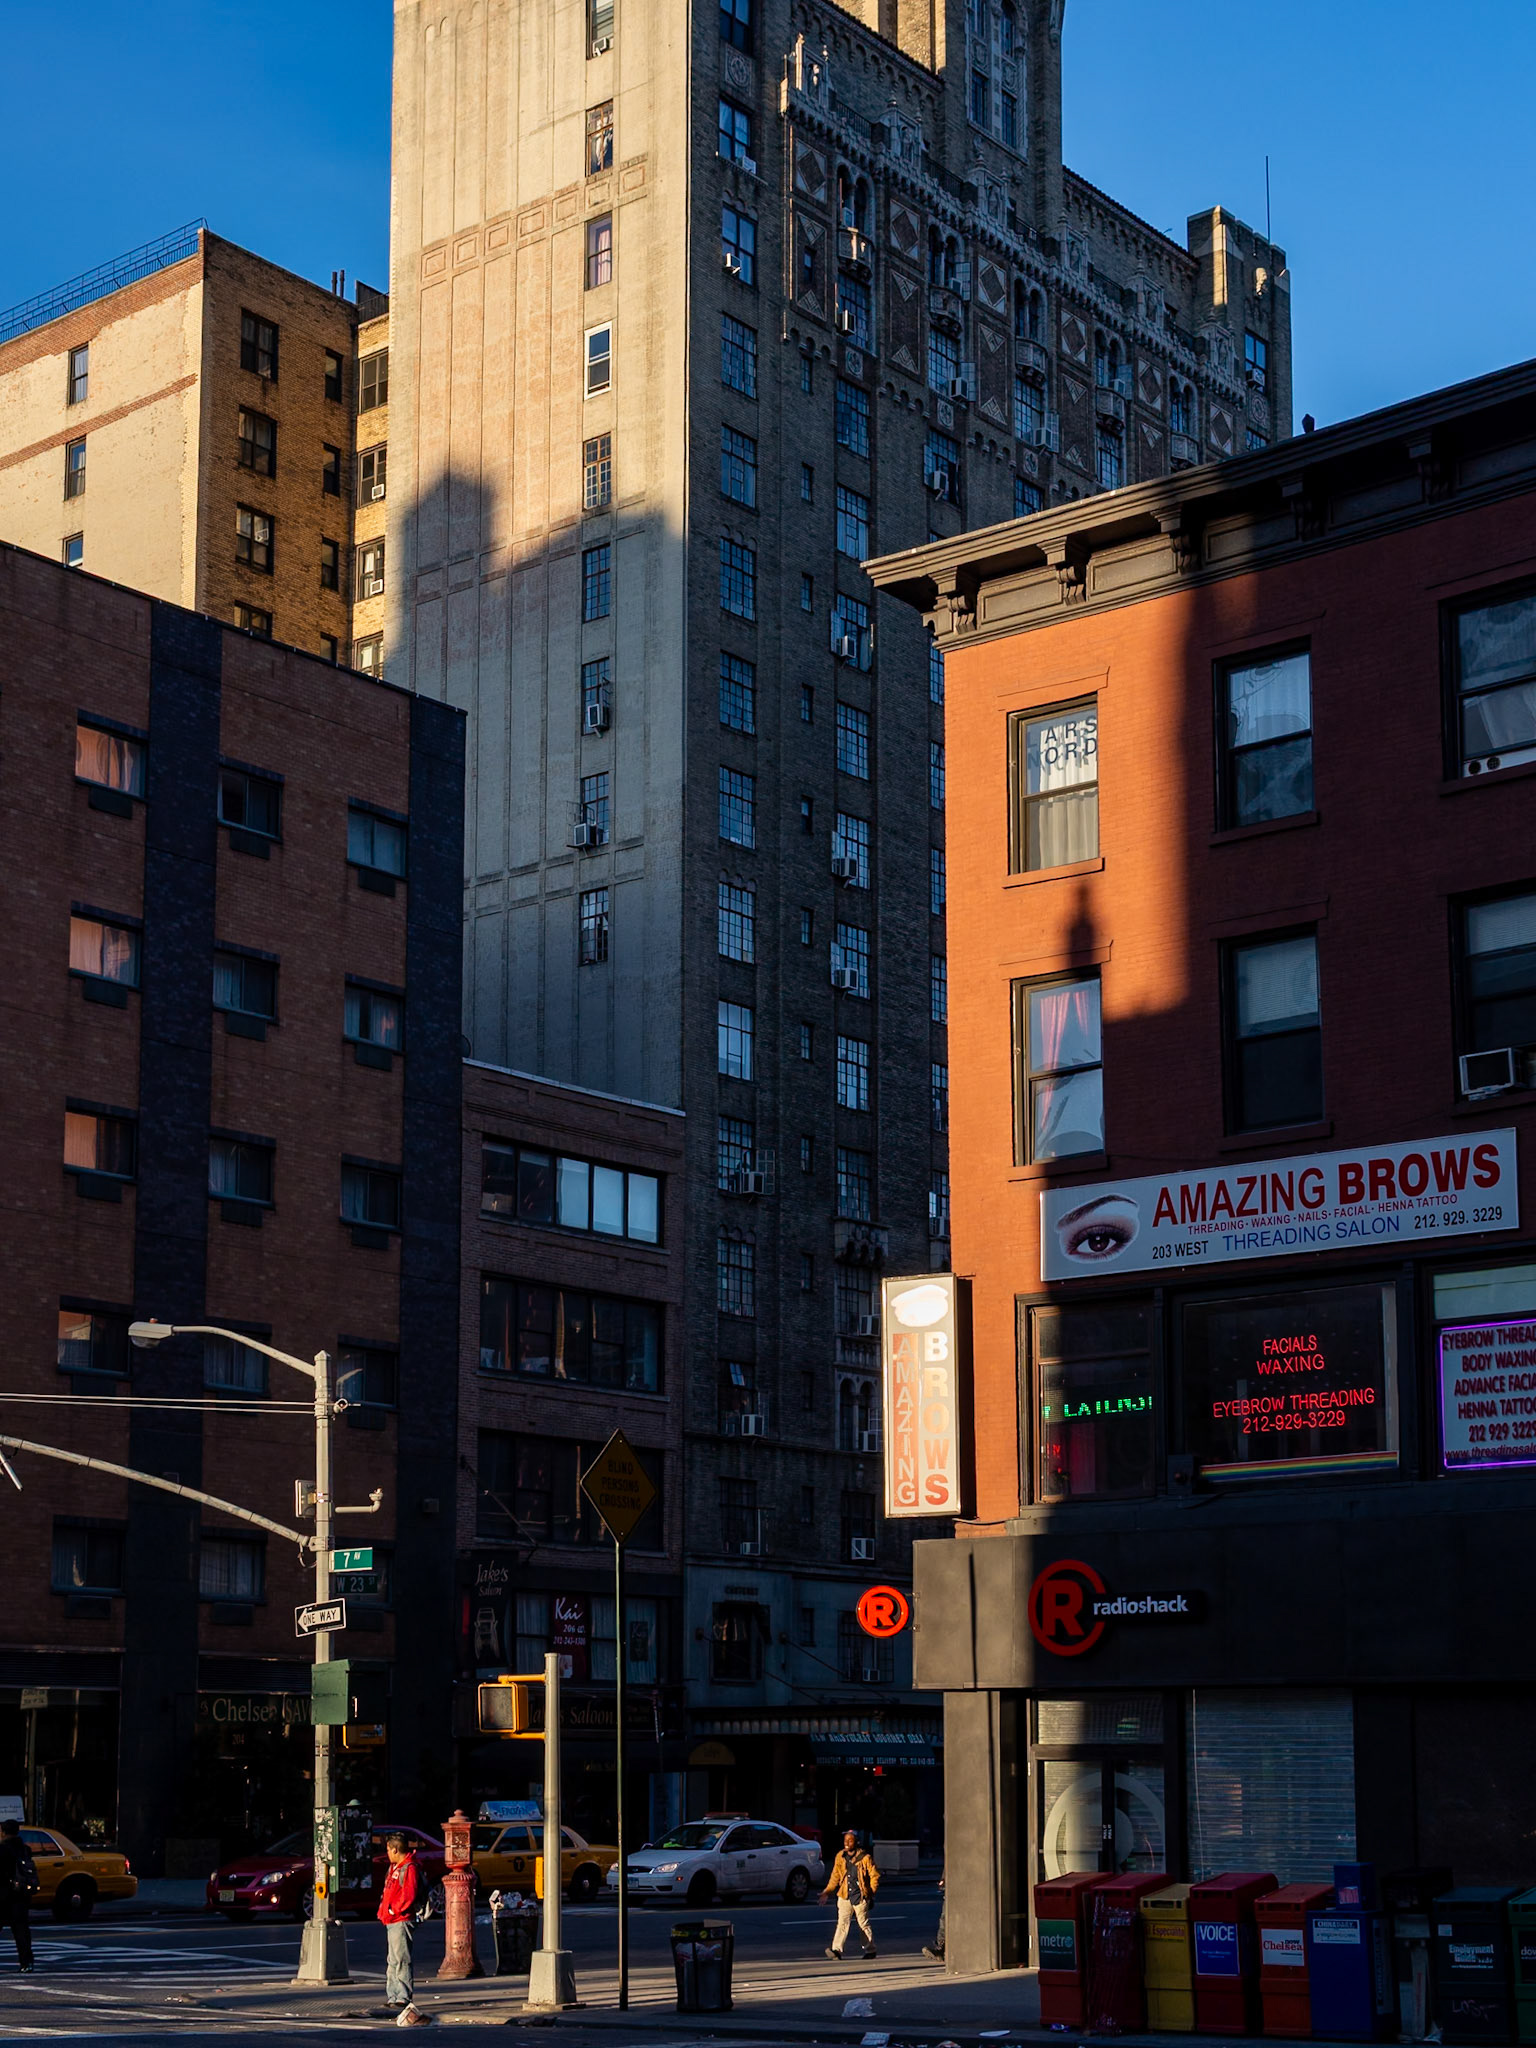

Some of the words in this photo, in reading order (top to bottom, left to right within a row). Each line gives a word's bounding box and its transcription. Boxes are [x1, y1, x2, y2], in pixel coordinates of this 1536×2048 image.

[1152, 1167, 1325, 1227] AMAZING
[1338, 1144, 1501, 1205] BROWS
[1188, 1220, 1244, 1235] THREADING
[1251, 1214, 1291, 1228] WAXING
[1298, 1210, 1328, 1222] NAILS
[1334, 1206, 1370, 1218] FACIAL
[1378, 1200, 1414, 1213] HENNA
[1415, 1193, 1458, 1208] TATTOO
[1472, 1205, 1503, 1223] 3229
[1222, 1223, 1331, 1251] THREADING
[1335, 1215, 1400, 1239] SALON
[1152, 1244, 1172, 1260] 203
[1174, 1240, 1209, 1257] WEST
[1263, 1335, 1318, 1355] FACIALS
[1442, 1330, 1493, 1351] EYEBROW
[1256, 1354, 1325, 1376] WAXING
[1462, 1353, 1491, 1372] BODY
[1454, 1376, 1505, 1396] ADVANCE
[1213, 1395, 1286, 1418] EYEBROW
[1290, 1387, 1375, 1411] THREADING
[1458, 1400, 1498, 1419] HENNA
[896, 1336, 916, 1505] AMAZING
[923, 1330, 950, 1505] BROWS
[1242, 1410, 1346, 1434] 212-929-3229
[1469, 1424, 1485, 1443] 212
[1489, 1422, 1508, 1441] 929
[344, 1552, 350, 1568] 7
[474, 1559, 509, 1585] Jake's
[336, 1577, 345, 1592] W
[350, 1576, 364, 1592] 23
[555, 1596, 584, 1621] Kai
[1093, 1595, 1189, 1615] radioshack
[303, 1613, 315, 1625] ONE
[320, 1609, 337, 1622] WAY
[1200, 1925, 1235, 1941] VOICE
